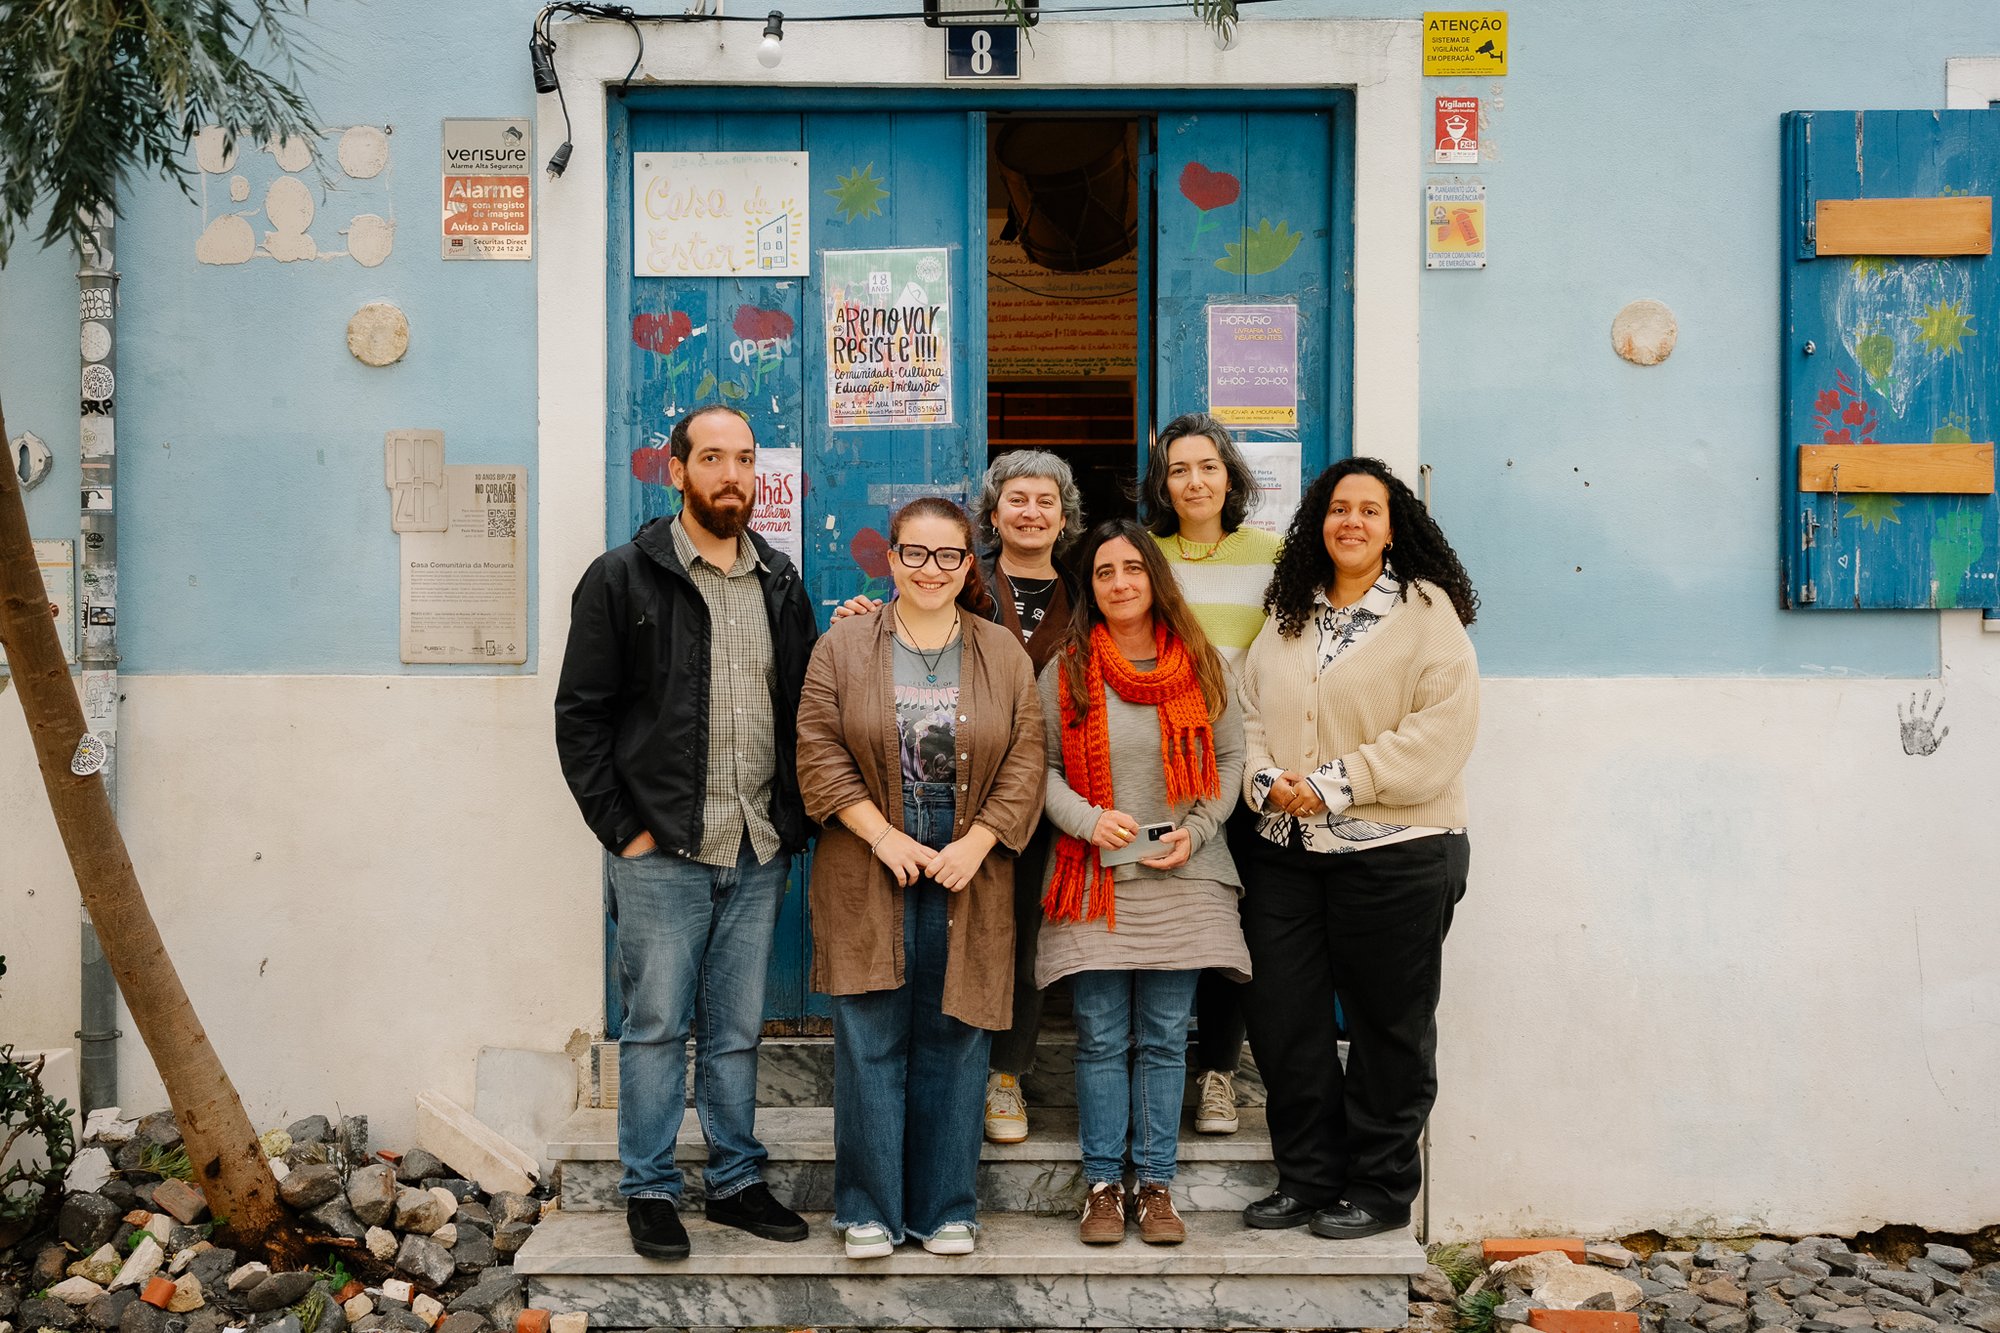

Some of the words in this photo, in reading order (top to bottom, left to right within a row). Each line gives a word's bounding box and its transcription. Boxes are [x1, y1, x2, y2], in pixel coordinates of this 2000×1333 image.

[1429, 17, 1502, 33] ATENÇÃO
[971, 30, 993, 75] 8
[1432, 44, 1470, 52] VIGILÂNCIA
[1437, 55, 1476, 63] OPERAÇÃO
[1438, 100, 1476, 110] Vigilante
[446, 149, 526, 161] verisure
[490, 162, 523, 171] Segurança
[449, 179, 525, 198] Alarme
[493, 200, 525, 211] registo
[473, 209, 485, 218] de
[487, 209, 525, 220] imagens
[450, 222, 480, 232] Aviso
[481, 221, 489, 232] à
[491, 221, 525, 232] Polícia
[872, 274, 888, 285] 18
[836, 307, 845, 323] A
[845, 306, 941, 337] Renovar
[1219, 315, 1272, 326] HORÁRIO
[730, 334, 792, 366] OPEN
[833, 337, 910, 364] Resiste
[834, 367, 894, 380] Comunidade
[898, 366, 944, 379] Cultura
[1219, 366, 1246, 376] TERÇA
[1248, 366, 1255, 374] E
[1258, 366, 1289, 374] QUINTA
[1254, 377, 1289, 386] 20H00
[835, 380, 885, 395] Educação
[891, 380, 941, 393] Inclusão
[475, 483, 484, 494] NO
[429, 560, 472, 569] Comunitária
[483, 561, 514, 569] Mouraria
